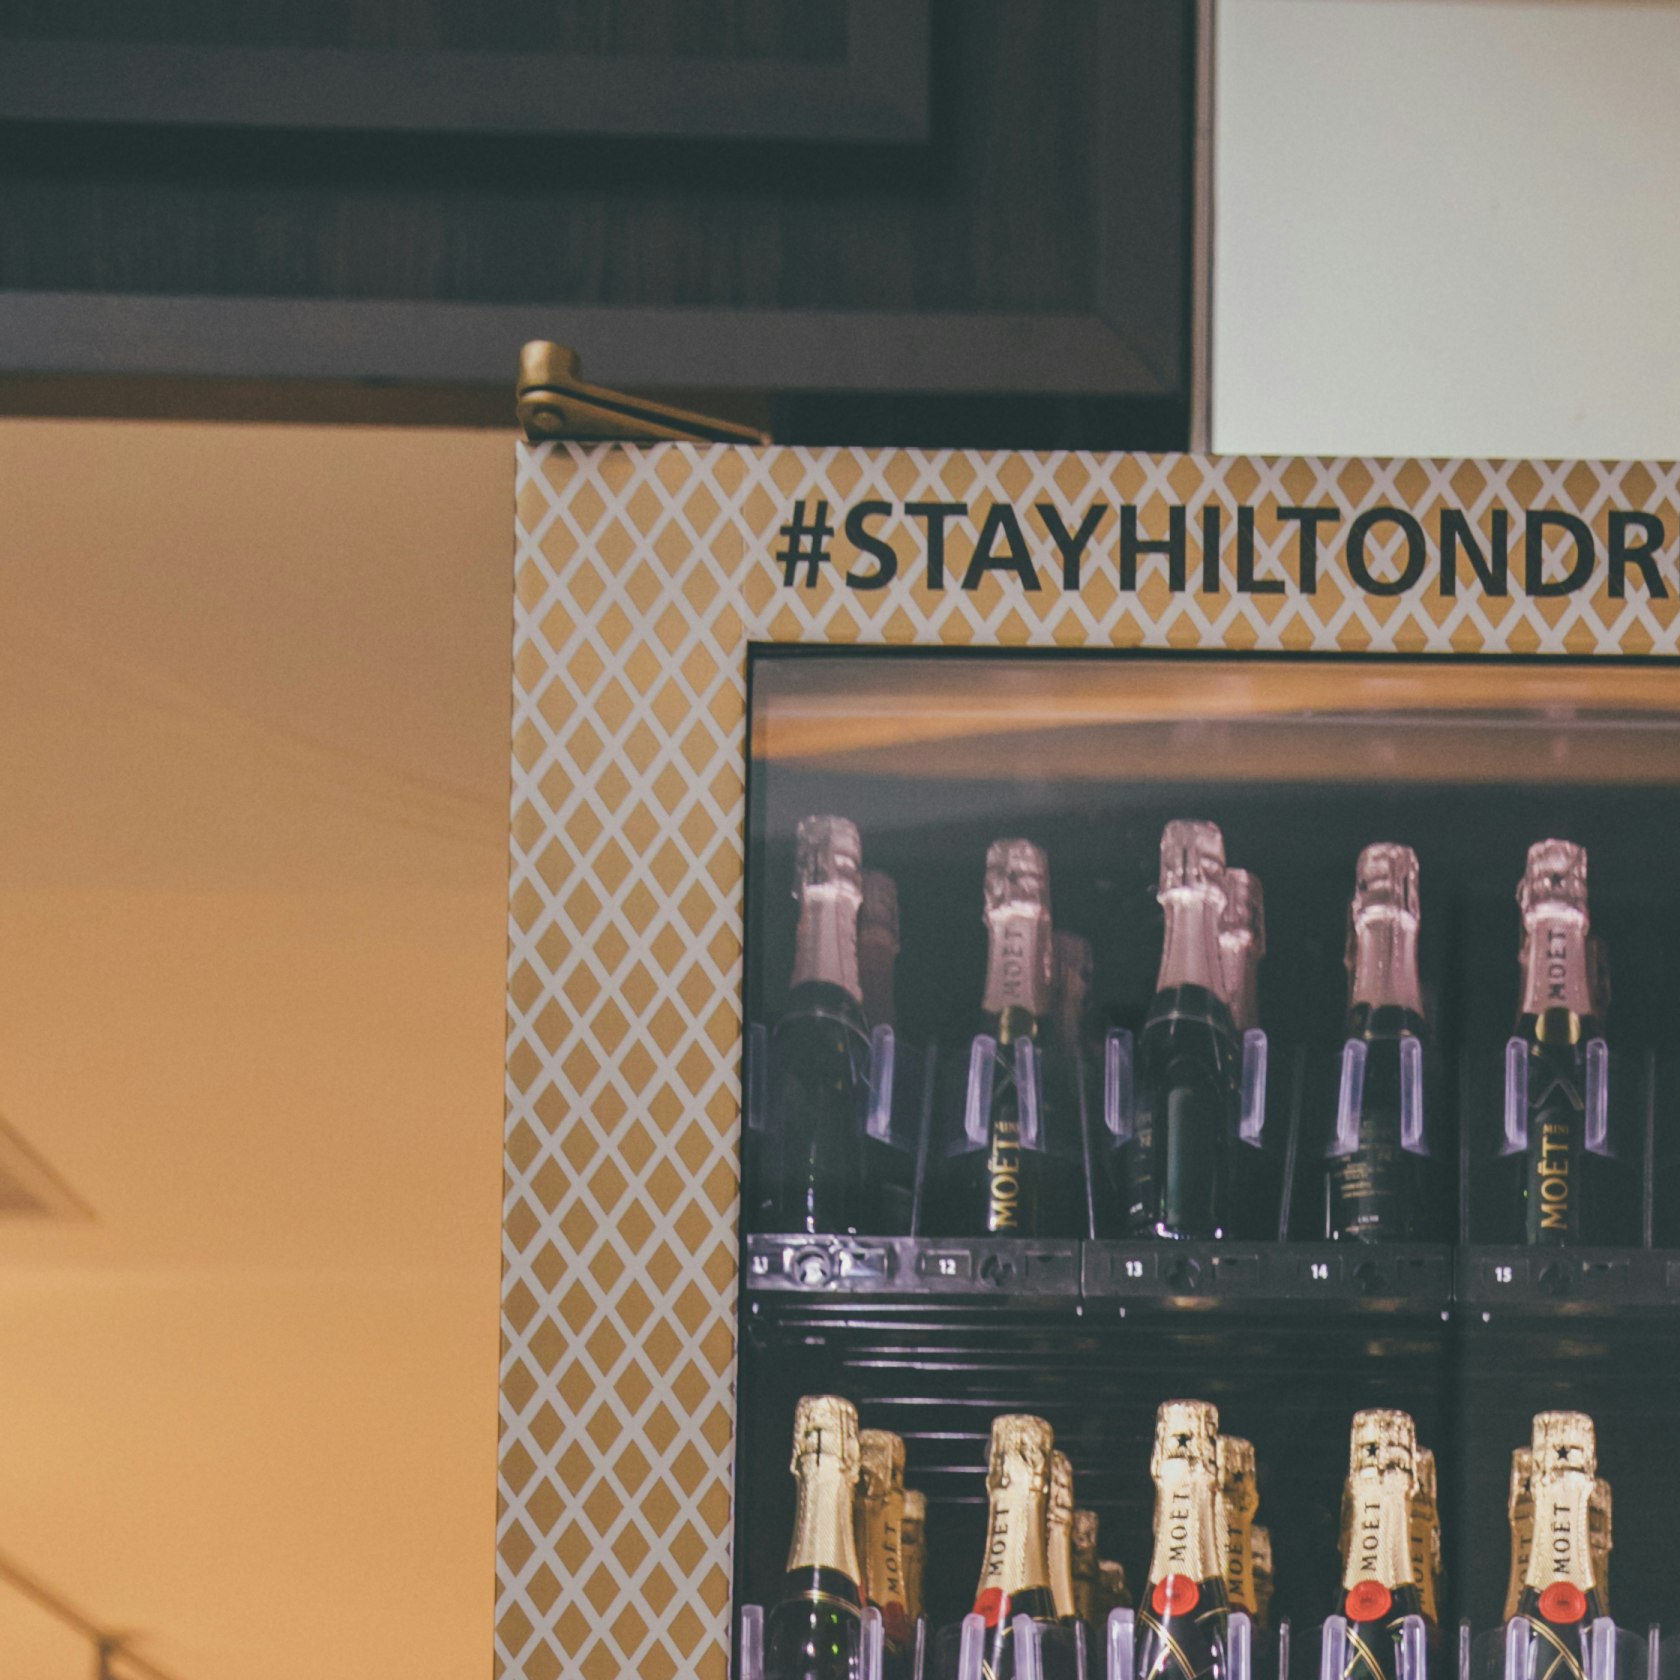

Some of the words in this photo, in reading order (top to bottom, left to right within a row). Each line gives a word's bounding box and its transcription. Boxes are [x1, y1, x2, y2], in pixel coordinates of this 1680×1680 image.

[1537, 1138, 1569, 1230] MOËT
[939, 1259, 957, 1274] 12
[1126, 1261, 1143, 1276] 13
[1311, 1264, 1328, 1279] 14
[1496, 1267, 1512, 1282] 15
